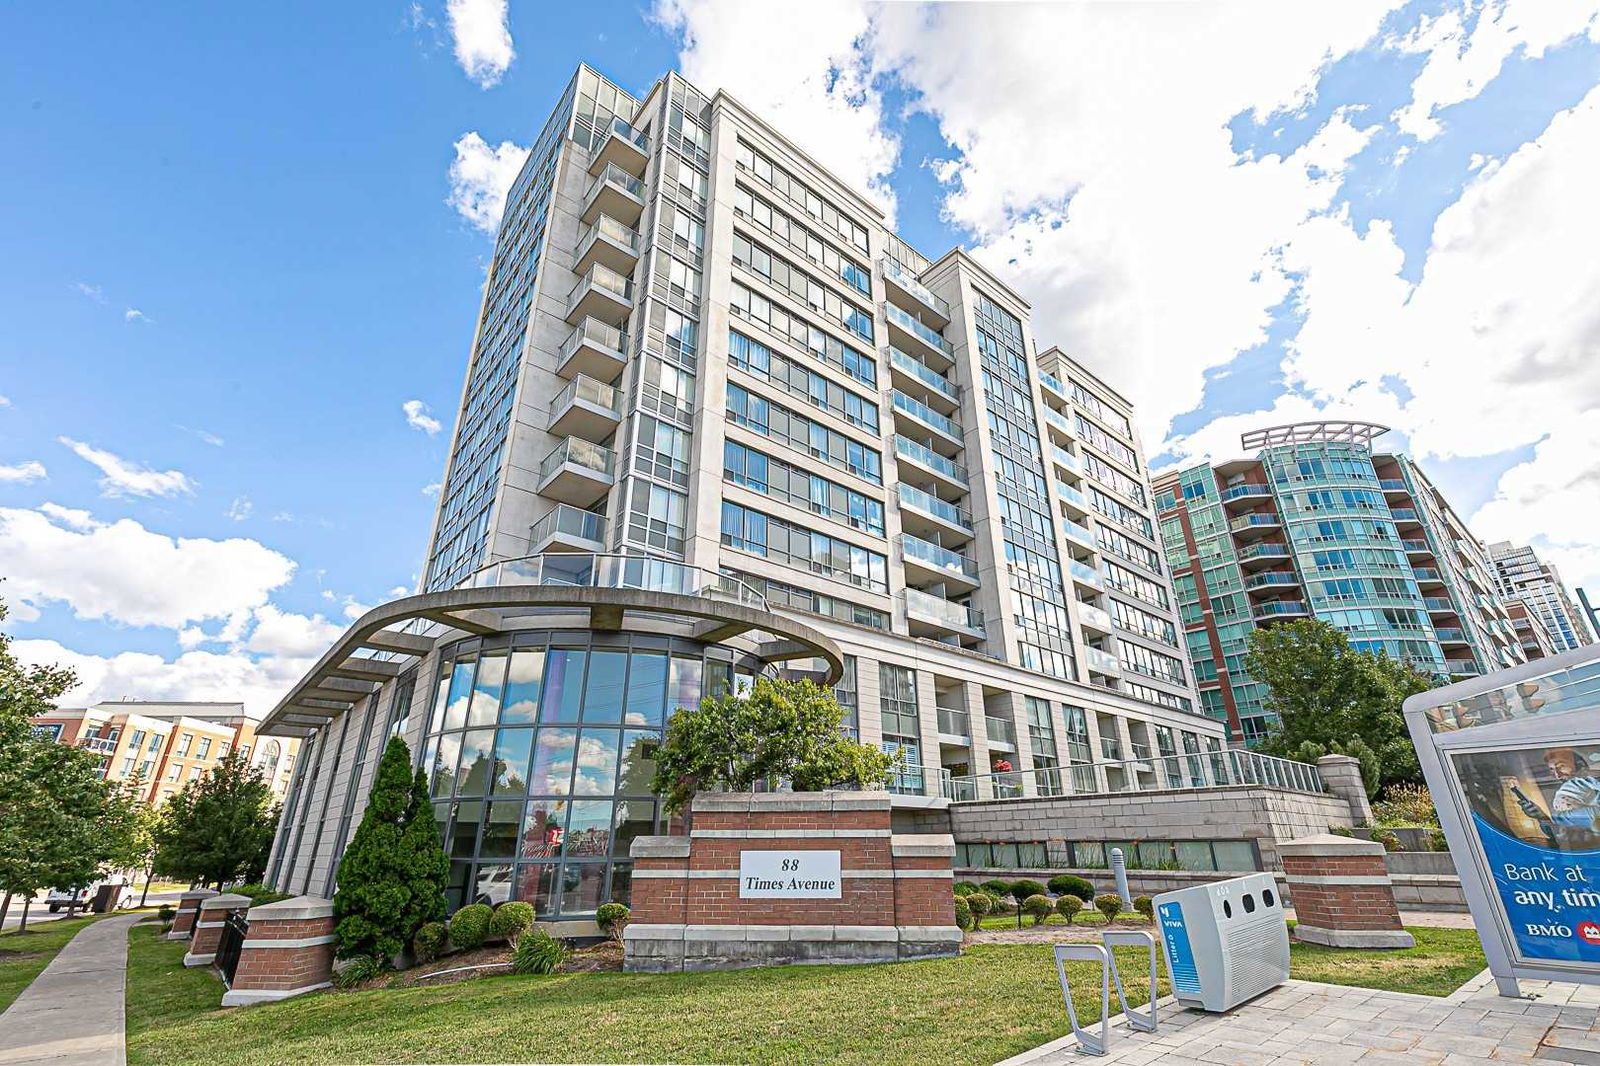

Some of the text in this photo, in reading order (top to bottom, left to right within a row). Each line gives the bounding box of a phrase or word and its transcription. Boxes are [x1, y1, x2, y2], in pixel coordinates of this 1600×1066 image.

[782, 858, 800, 872] 88
[1503, 862, 1587, 882] Bank at
[746, 877, 835, 890] Times Avenue
[1514, 890, 1554, 910] any
[1163, 920, 1183, 928] VIVA
[1525, 923, 1572, 938] BMO
